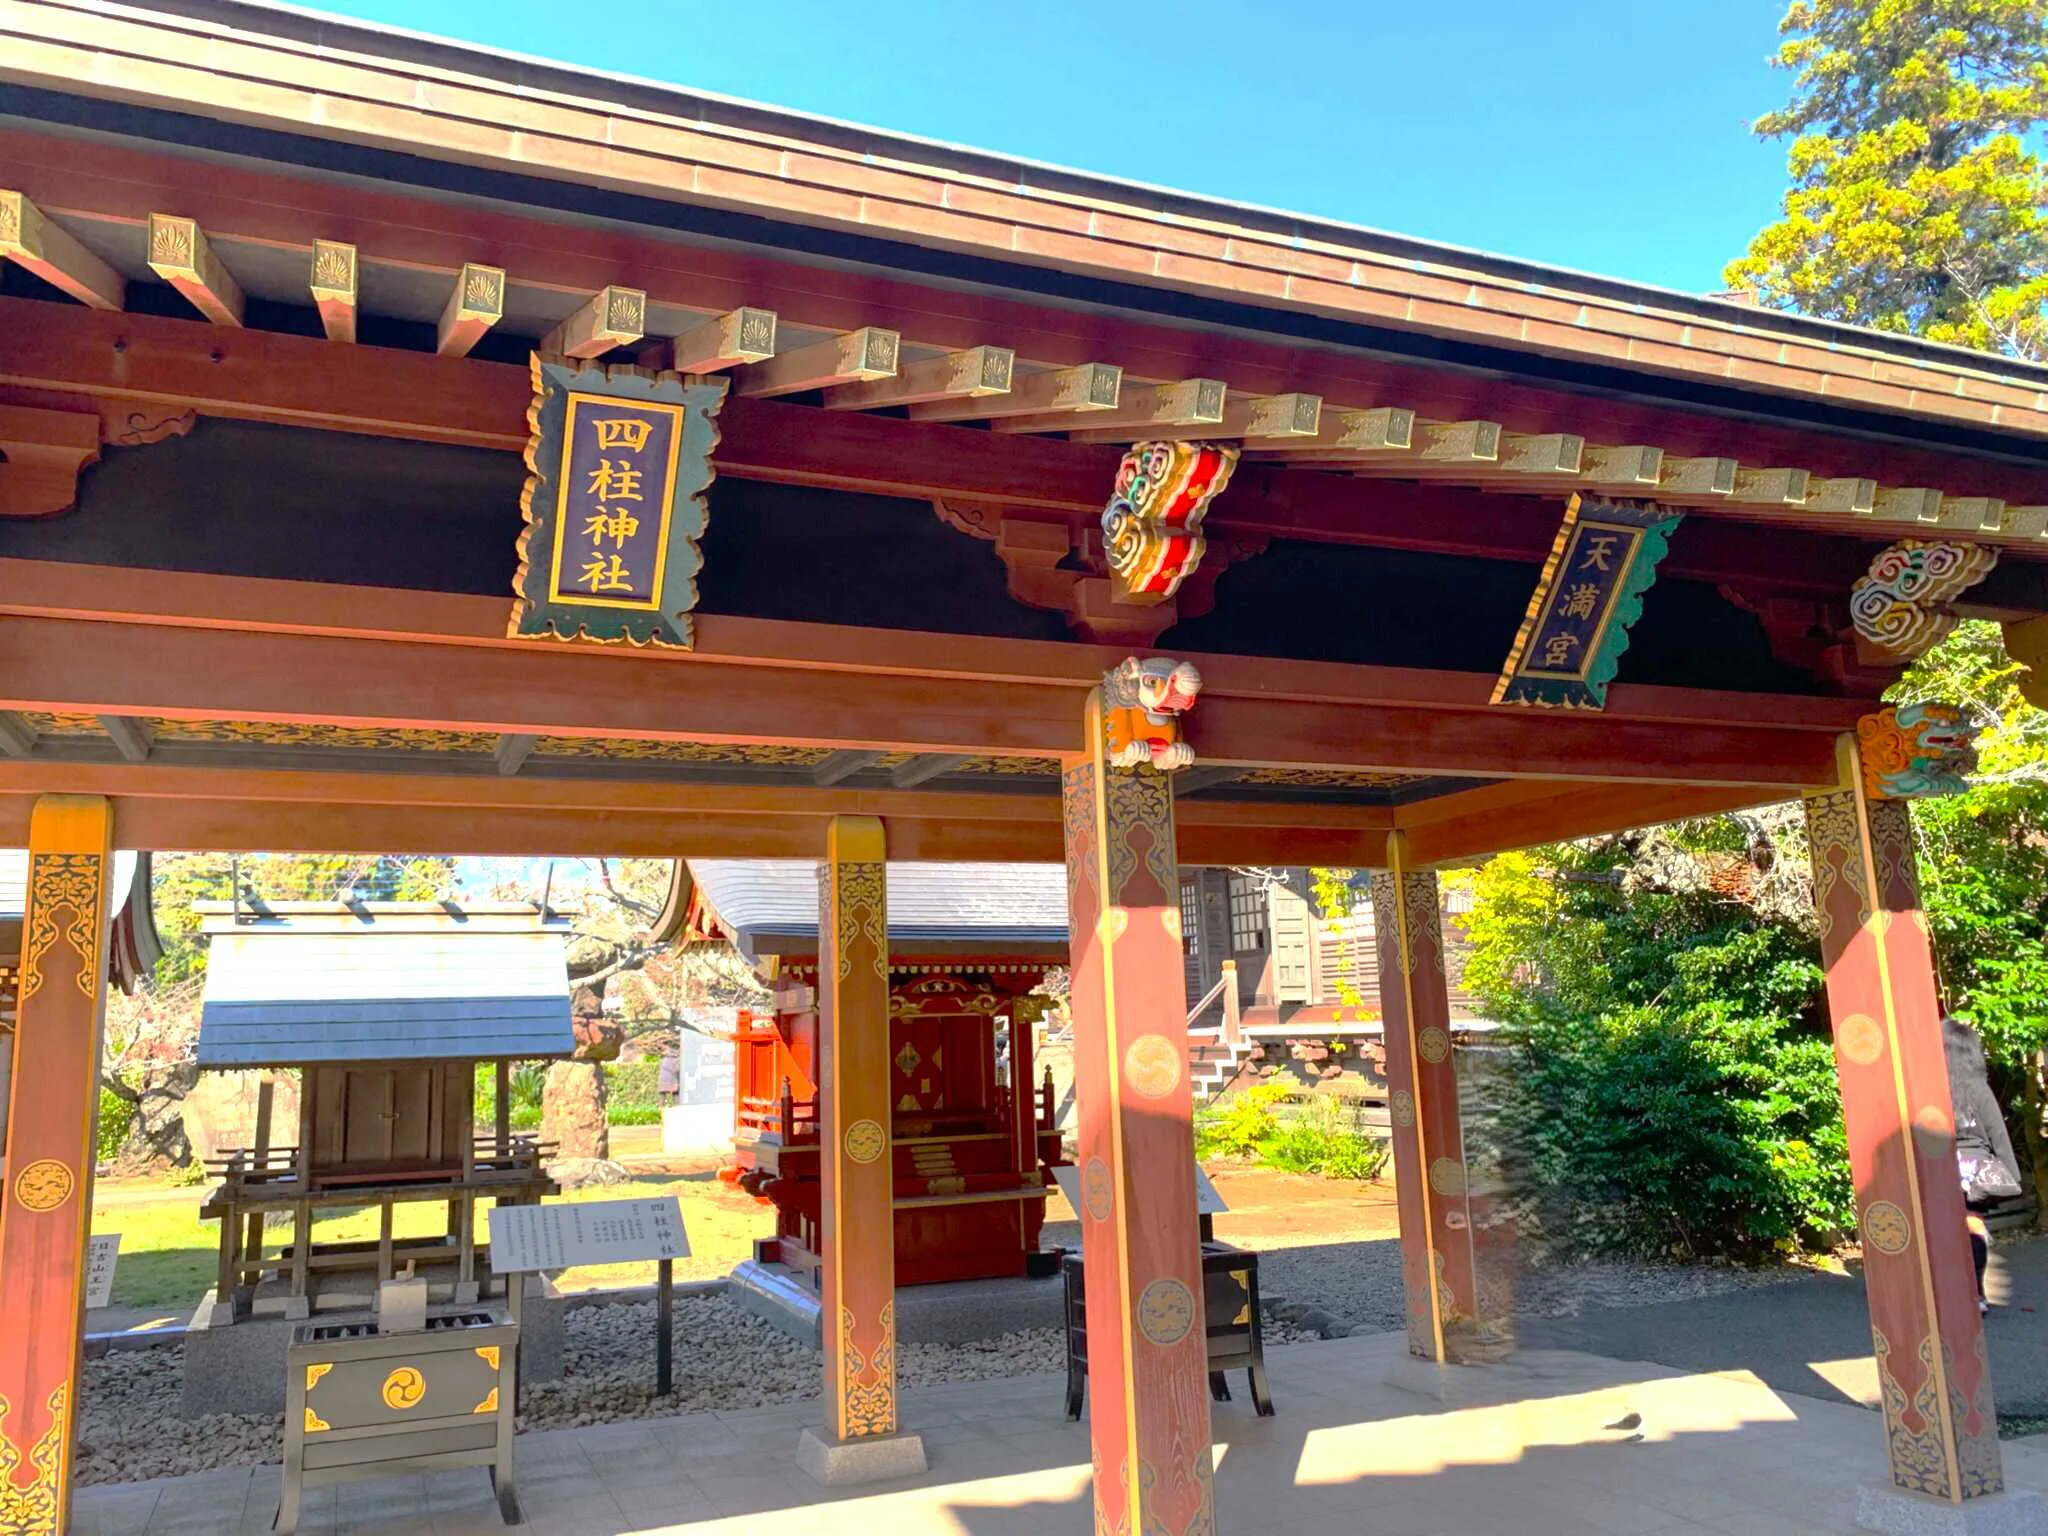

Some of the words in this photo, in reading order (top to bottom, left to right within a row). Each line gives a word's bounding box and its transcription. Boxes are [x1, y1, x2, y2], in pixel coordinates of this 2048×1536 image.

[577, 418, 653, 593] 四柱神社
[1545, 536, 1617, 666] 天満宮
